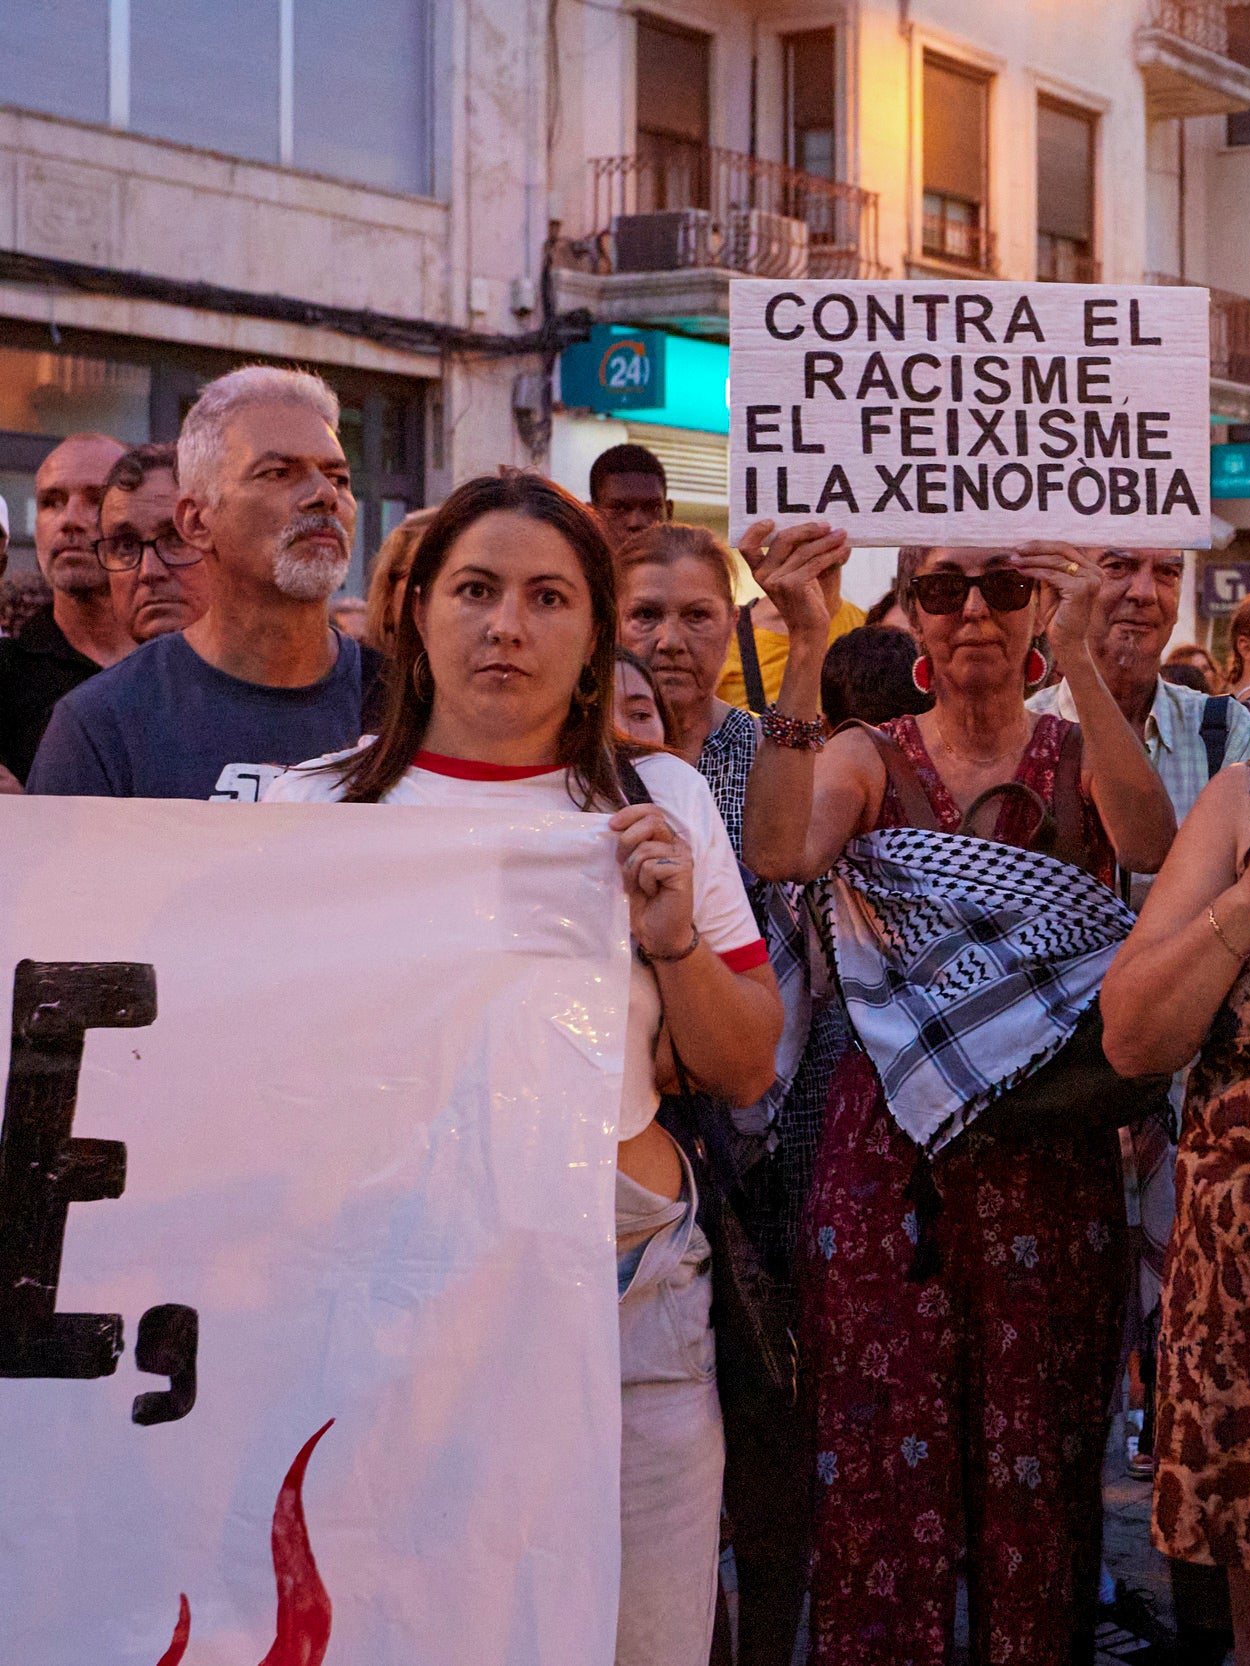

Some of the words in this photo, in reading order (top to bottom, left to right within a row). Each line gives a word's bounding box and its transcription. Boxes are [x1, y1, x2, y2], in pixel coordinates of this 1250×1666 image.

[764, 292, 1046, 344] CONTRA
[1083, 299, 1162, 346] EL
[745, 404, 826, 454] EL
[860, 406, 1172, 460] FEIXISME
[744, 466, 758, 515] I
[776, 464, 860, 514] LA
[871, 457, 1201, 516] XENOFÒBIA
